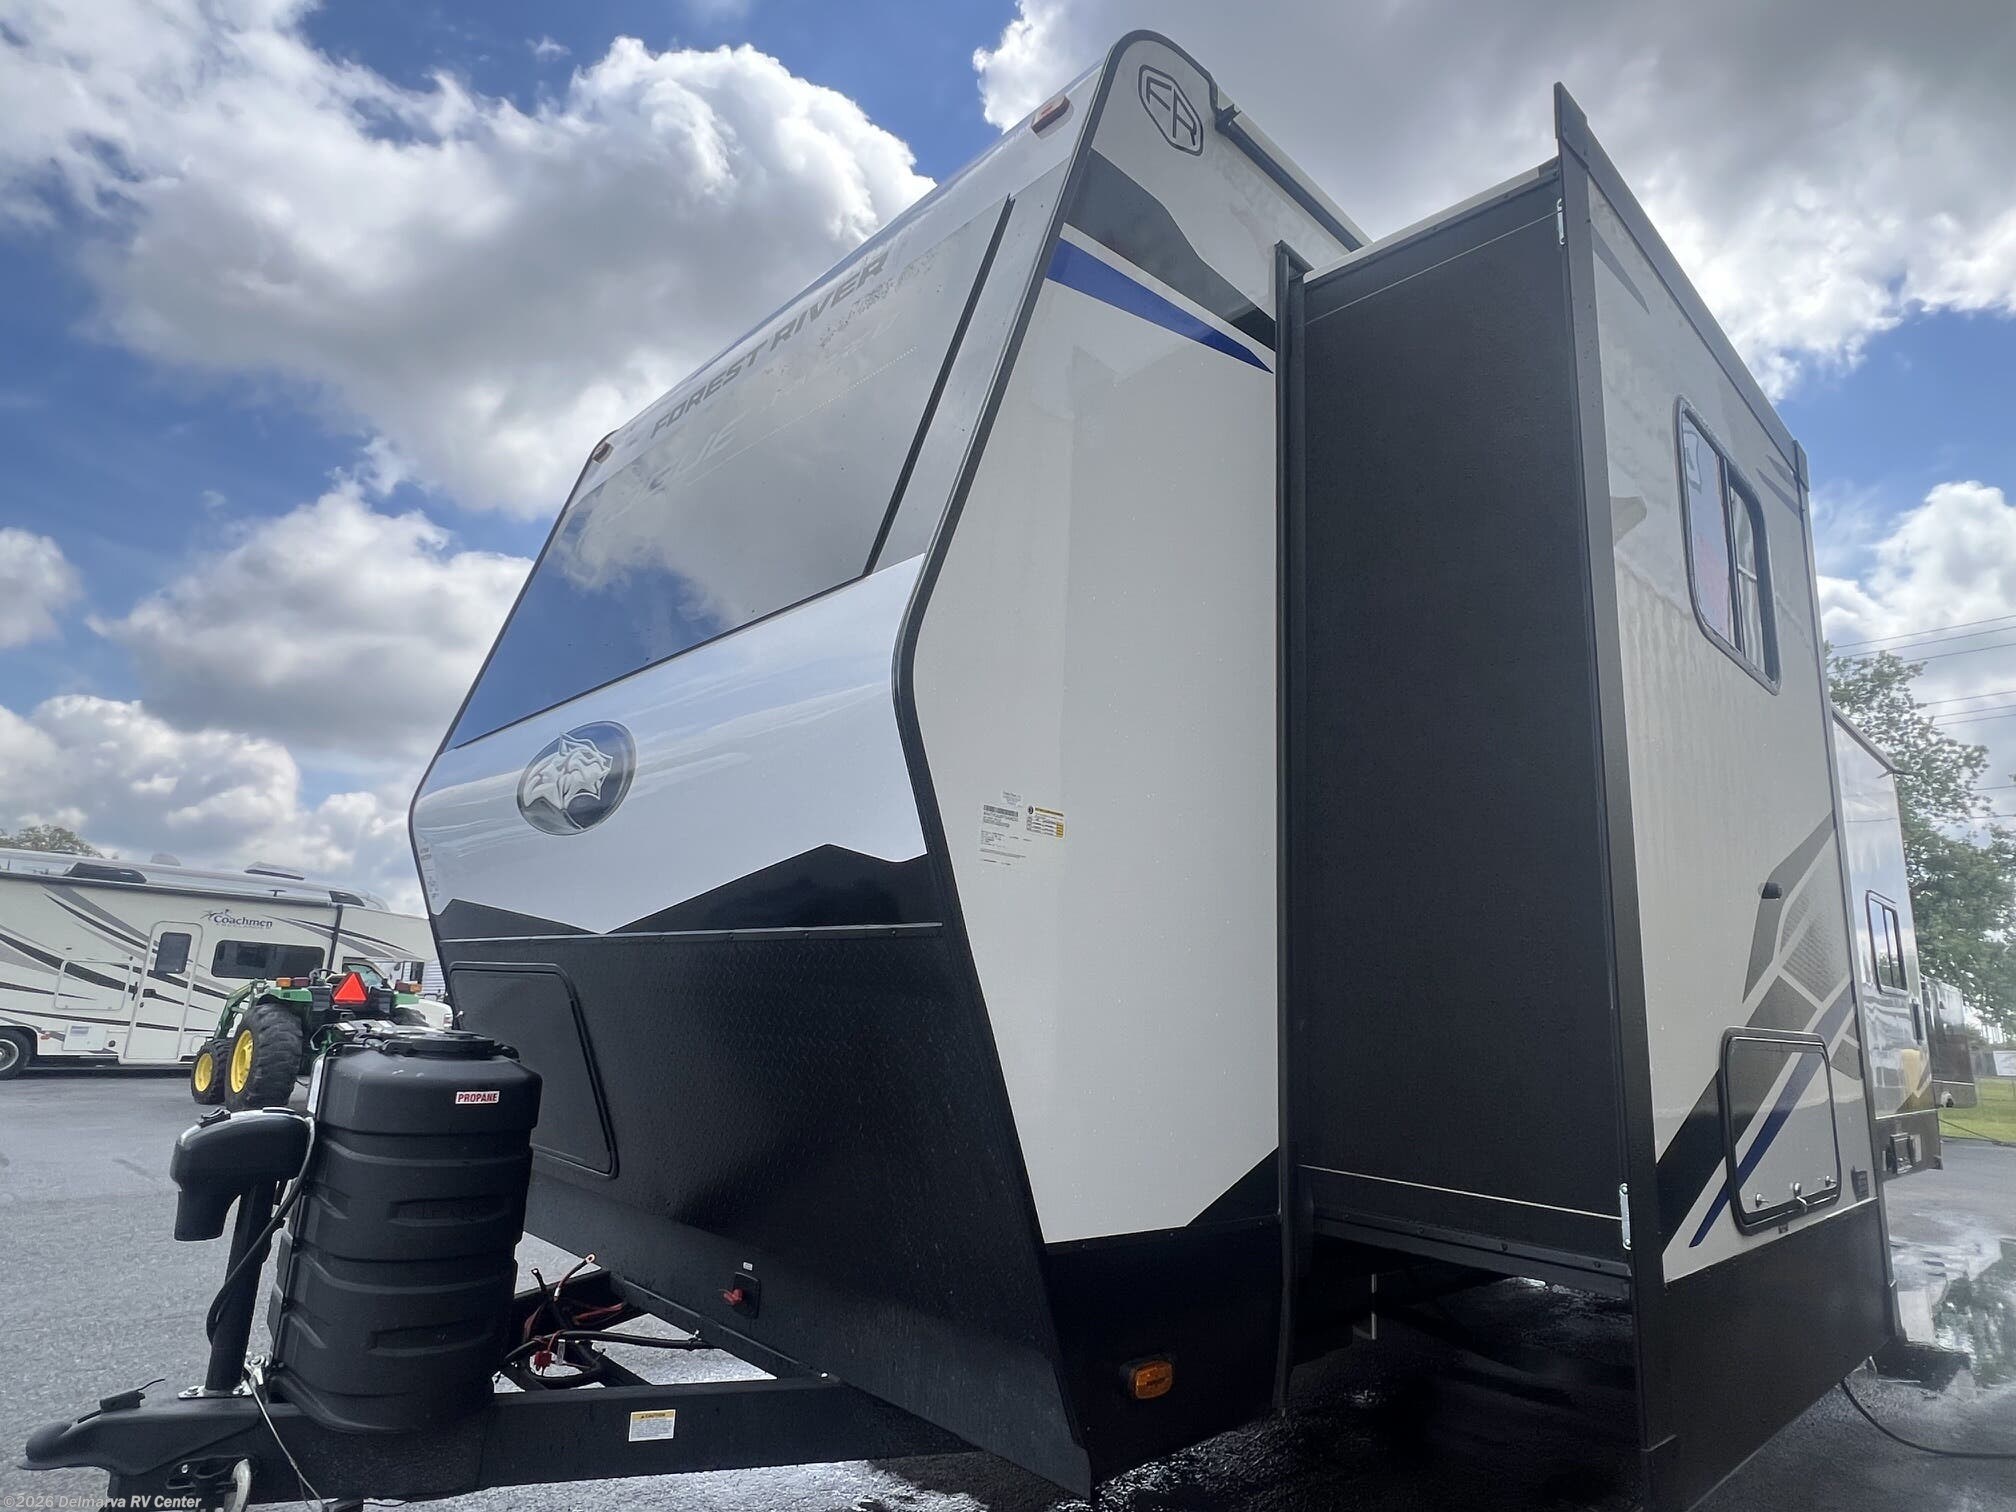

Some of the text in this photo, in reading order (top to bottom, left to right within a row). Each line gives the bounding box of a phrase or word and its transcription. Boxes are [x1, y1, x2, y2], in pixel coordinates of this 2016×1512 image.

[650, 250, 890, 440] FOREST RIVER
[213, 914, 273, 928] Coachmen
[457, 1092, 498, 1103] PROPANE
